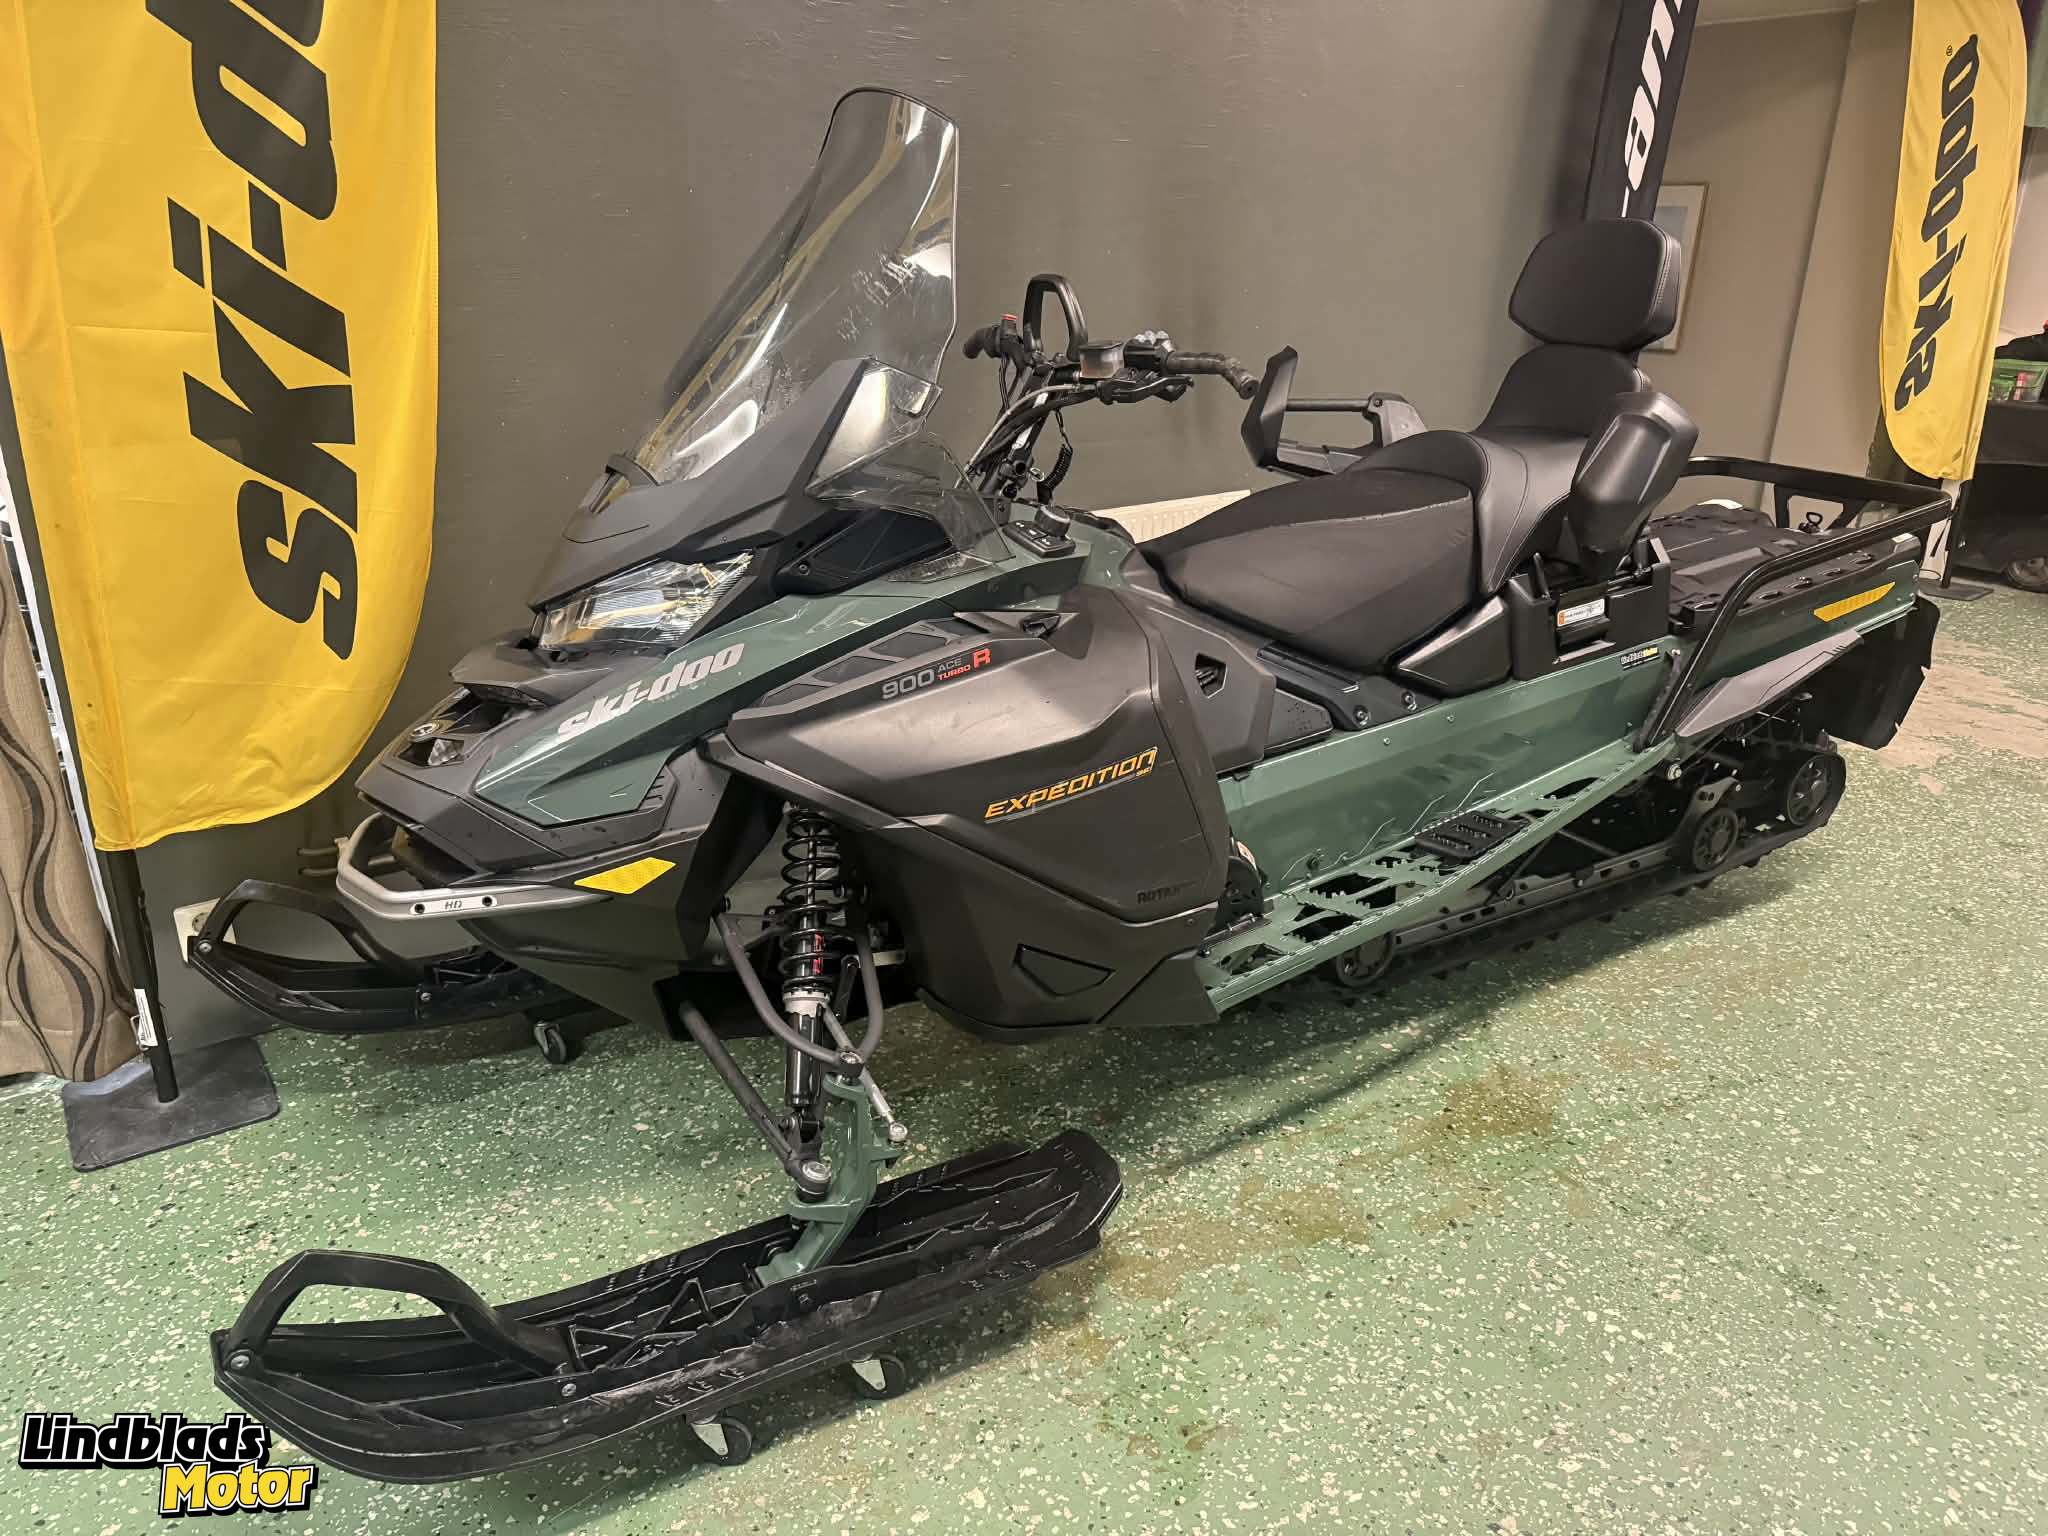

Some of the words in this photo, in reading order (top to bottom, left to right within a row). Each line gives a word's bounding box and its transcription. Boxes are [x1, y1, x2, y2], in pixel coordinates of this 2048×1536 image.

[882, 669, 935, 699] 900
[938, 658, 962, 673] ACE
[938, 664, 971, 680] TURBO
[973, 648, 991, 668] R
[984, 747, 1157, 818] EXPEDITION
[445, 900, 463, 910] HD
